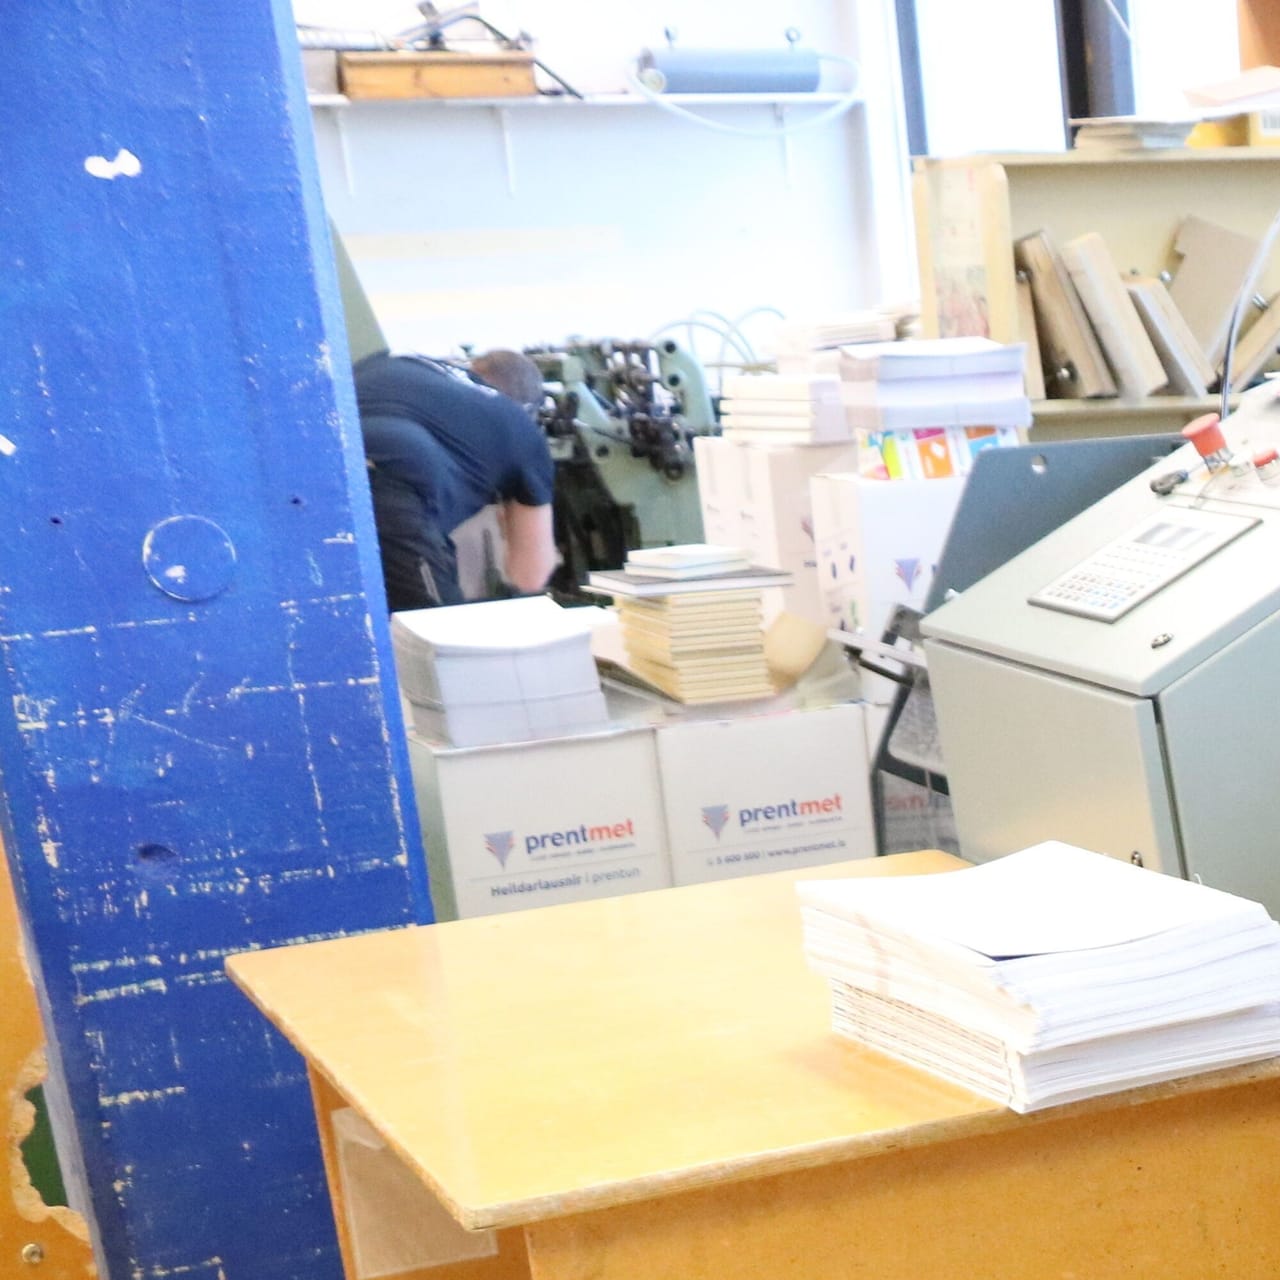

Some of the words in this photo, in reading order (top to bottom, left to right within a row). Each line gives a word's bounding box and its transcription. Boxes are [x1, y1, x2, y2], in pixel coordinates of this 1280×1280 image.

[739, 792, 843, 827] prentmet
[525, 818, 635, 854] prentmet
[490, 873, 582, 897] Heildarlausnir
